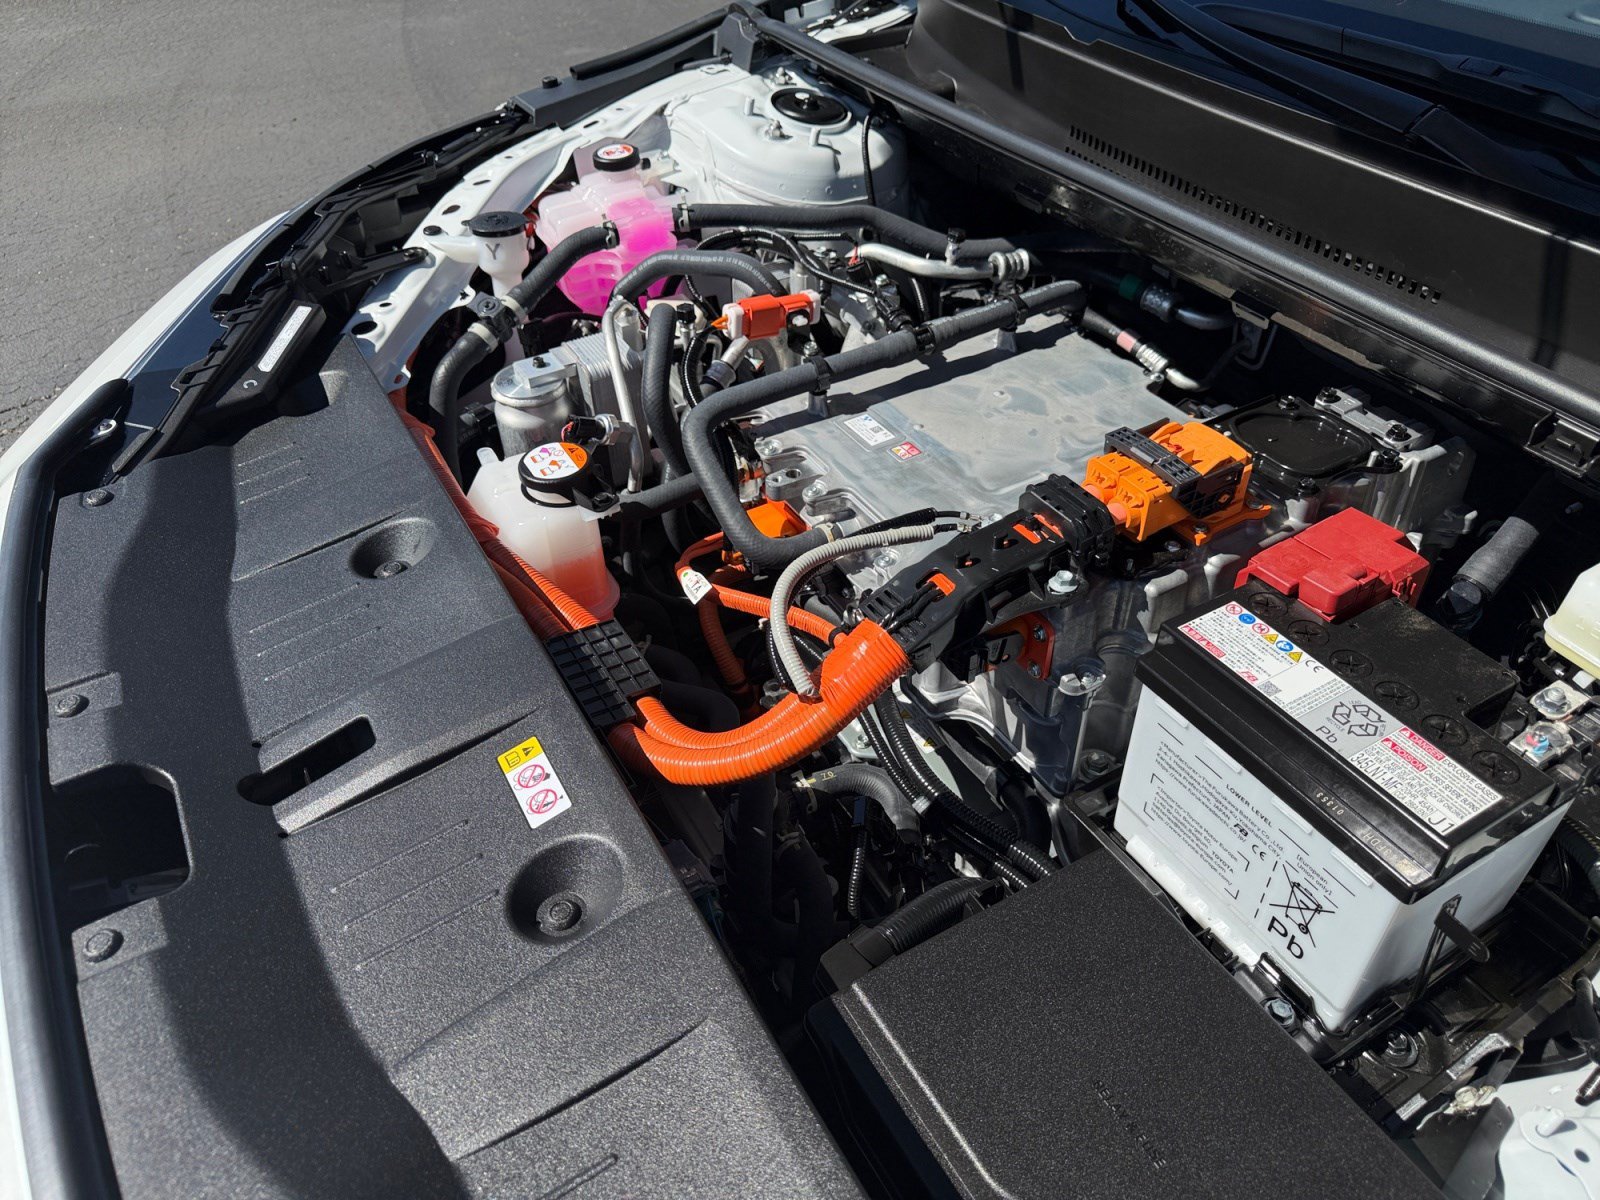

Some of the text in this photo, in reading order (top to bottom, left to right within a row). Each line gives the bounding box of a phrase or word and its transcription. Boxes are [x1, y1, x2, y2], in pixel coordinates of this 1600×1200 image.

[1315, 725, 1338, 743] Pb
[1351, 753, 1402, 791] 345LN1-MF
[1392, 746, 1480, 813] POISON CAUSES SEVERE BURNS
[1409, 736, 1499, 801] DANGER EXPLOSIVE GASES
[1226, 784, 1273, 828] LOWER LEVEL
[1239, 810, 1261, 832] Battery
[1212, 851, 1234, 874] TOYOTA
[1219, 842, 1238, 863] Europe
[1296, 863, 1315, 881] Union
[1267, 916, 1303, 959] Pb
